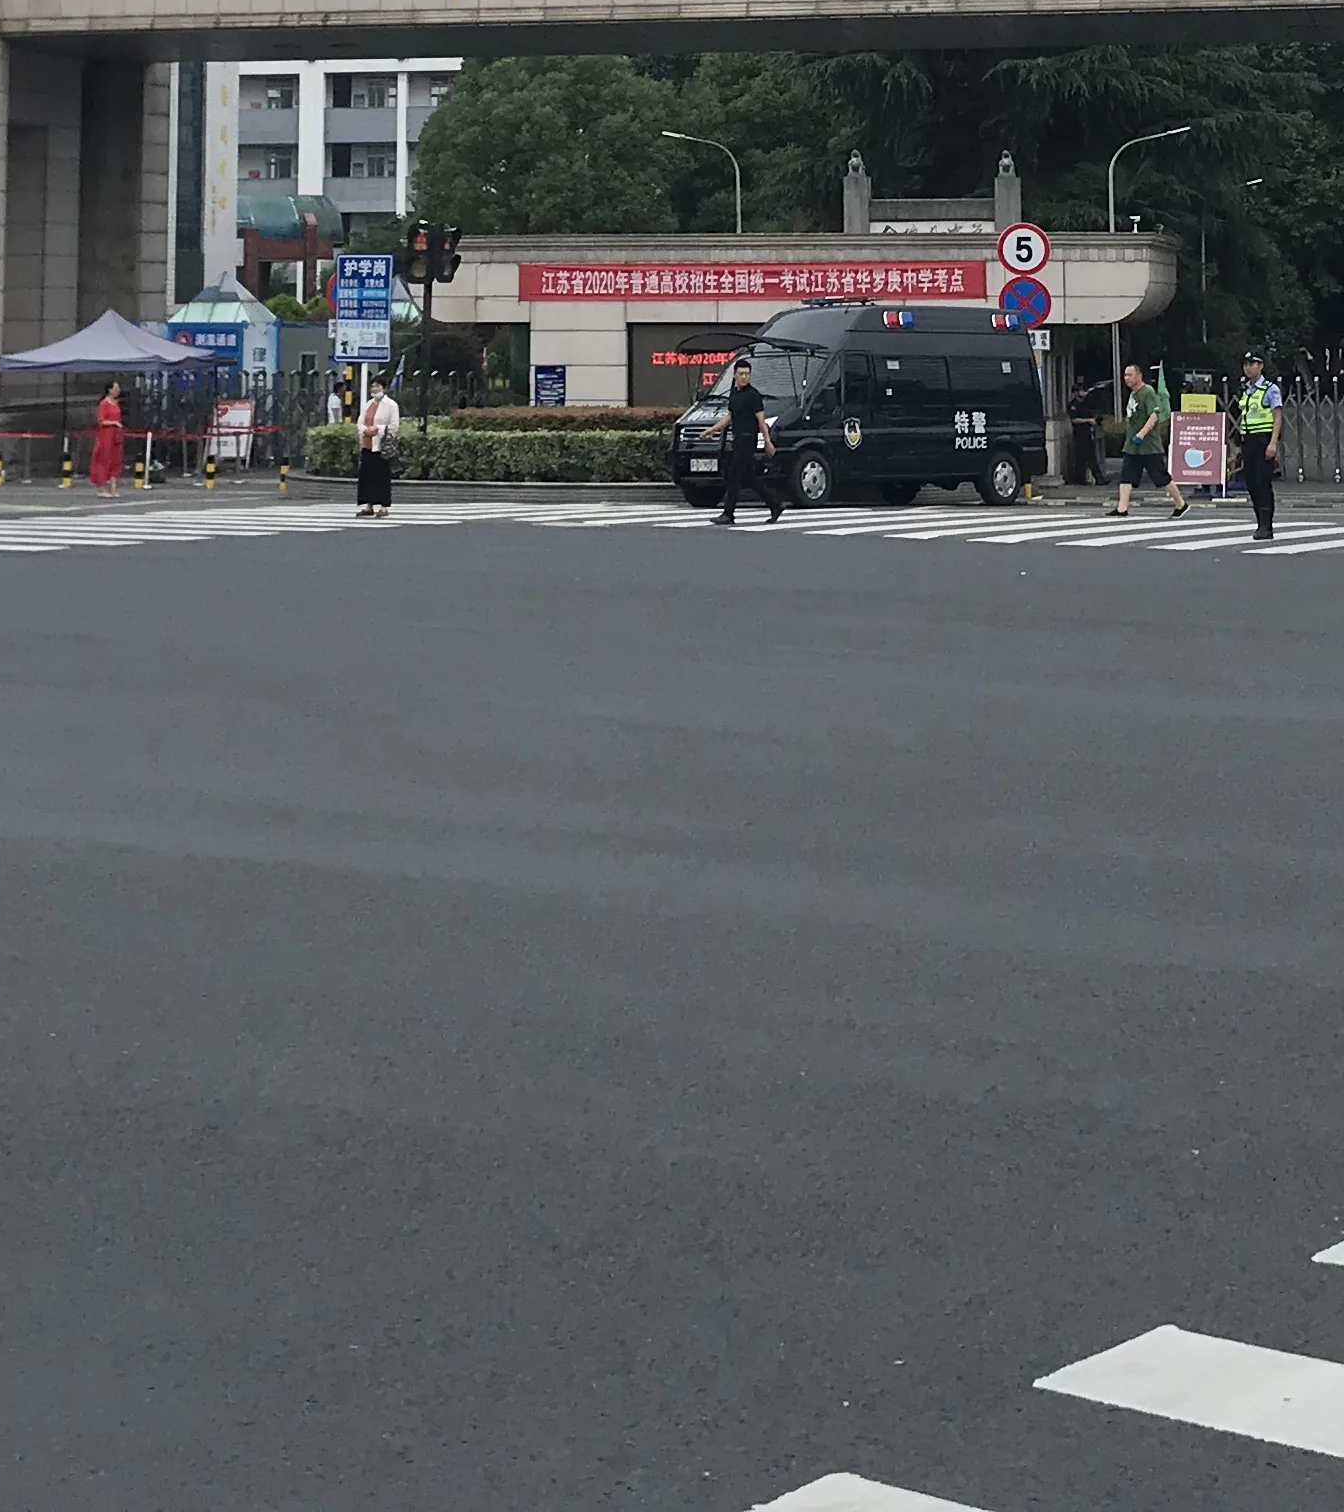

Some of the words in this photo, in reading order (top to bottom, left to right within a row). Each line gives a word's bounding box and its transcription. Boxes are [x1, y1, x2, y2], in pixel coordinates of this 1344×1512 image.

[1015, 236, 1033, 263] 5
[343, 259, 386, 277] 护学岗
[541, 268, 965, 295] 江苏省2020年普通高校招生全国统一考试江苏省华罗庚中学考点
[954, 410, 987, 434] 特警
[955, 436, 988, 449] POLICE
